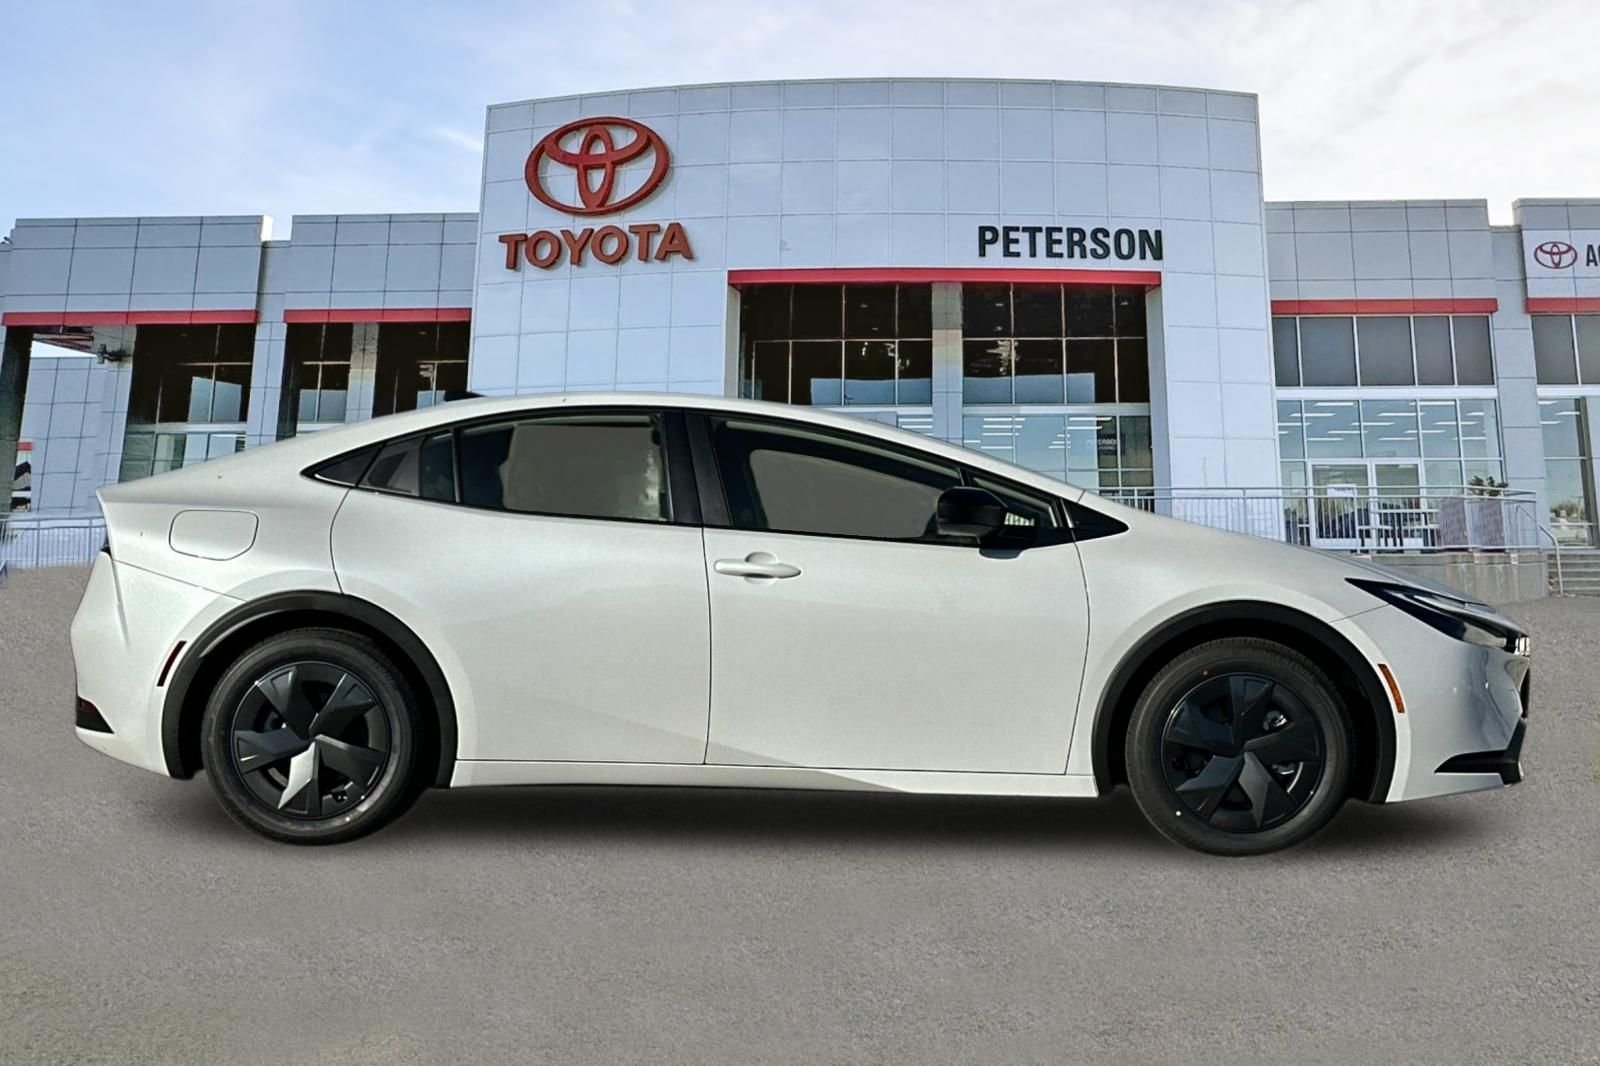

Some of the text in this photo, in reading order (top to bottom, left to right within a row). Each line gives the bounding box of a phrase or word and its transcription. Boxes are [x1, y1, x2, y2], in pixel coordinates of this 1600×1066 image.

[498, 222, 694, 270] TOYOTA
[978, 225, 1164, 261] PETERSON
[1586, 244, 1600, 267] A
